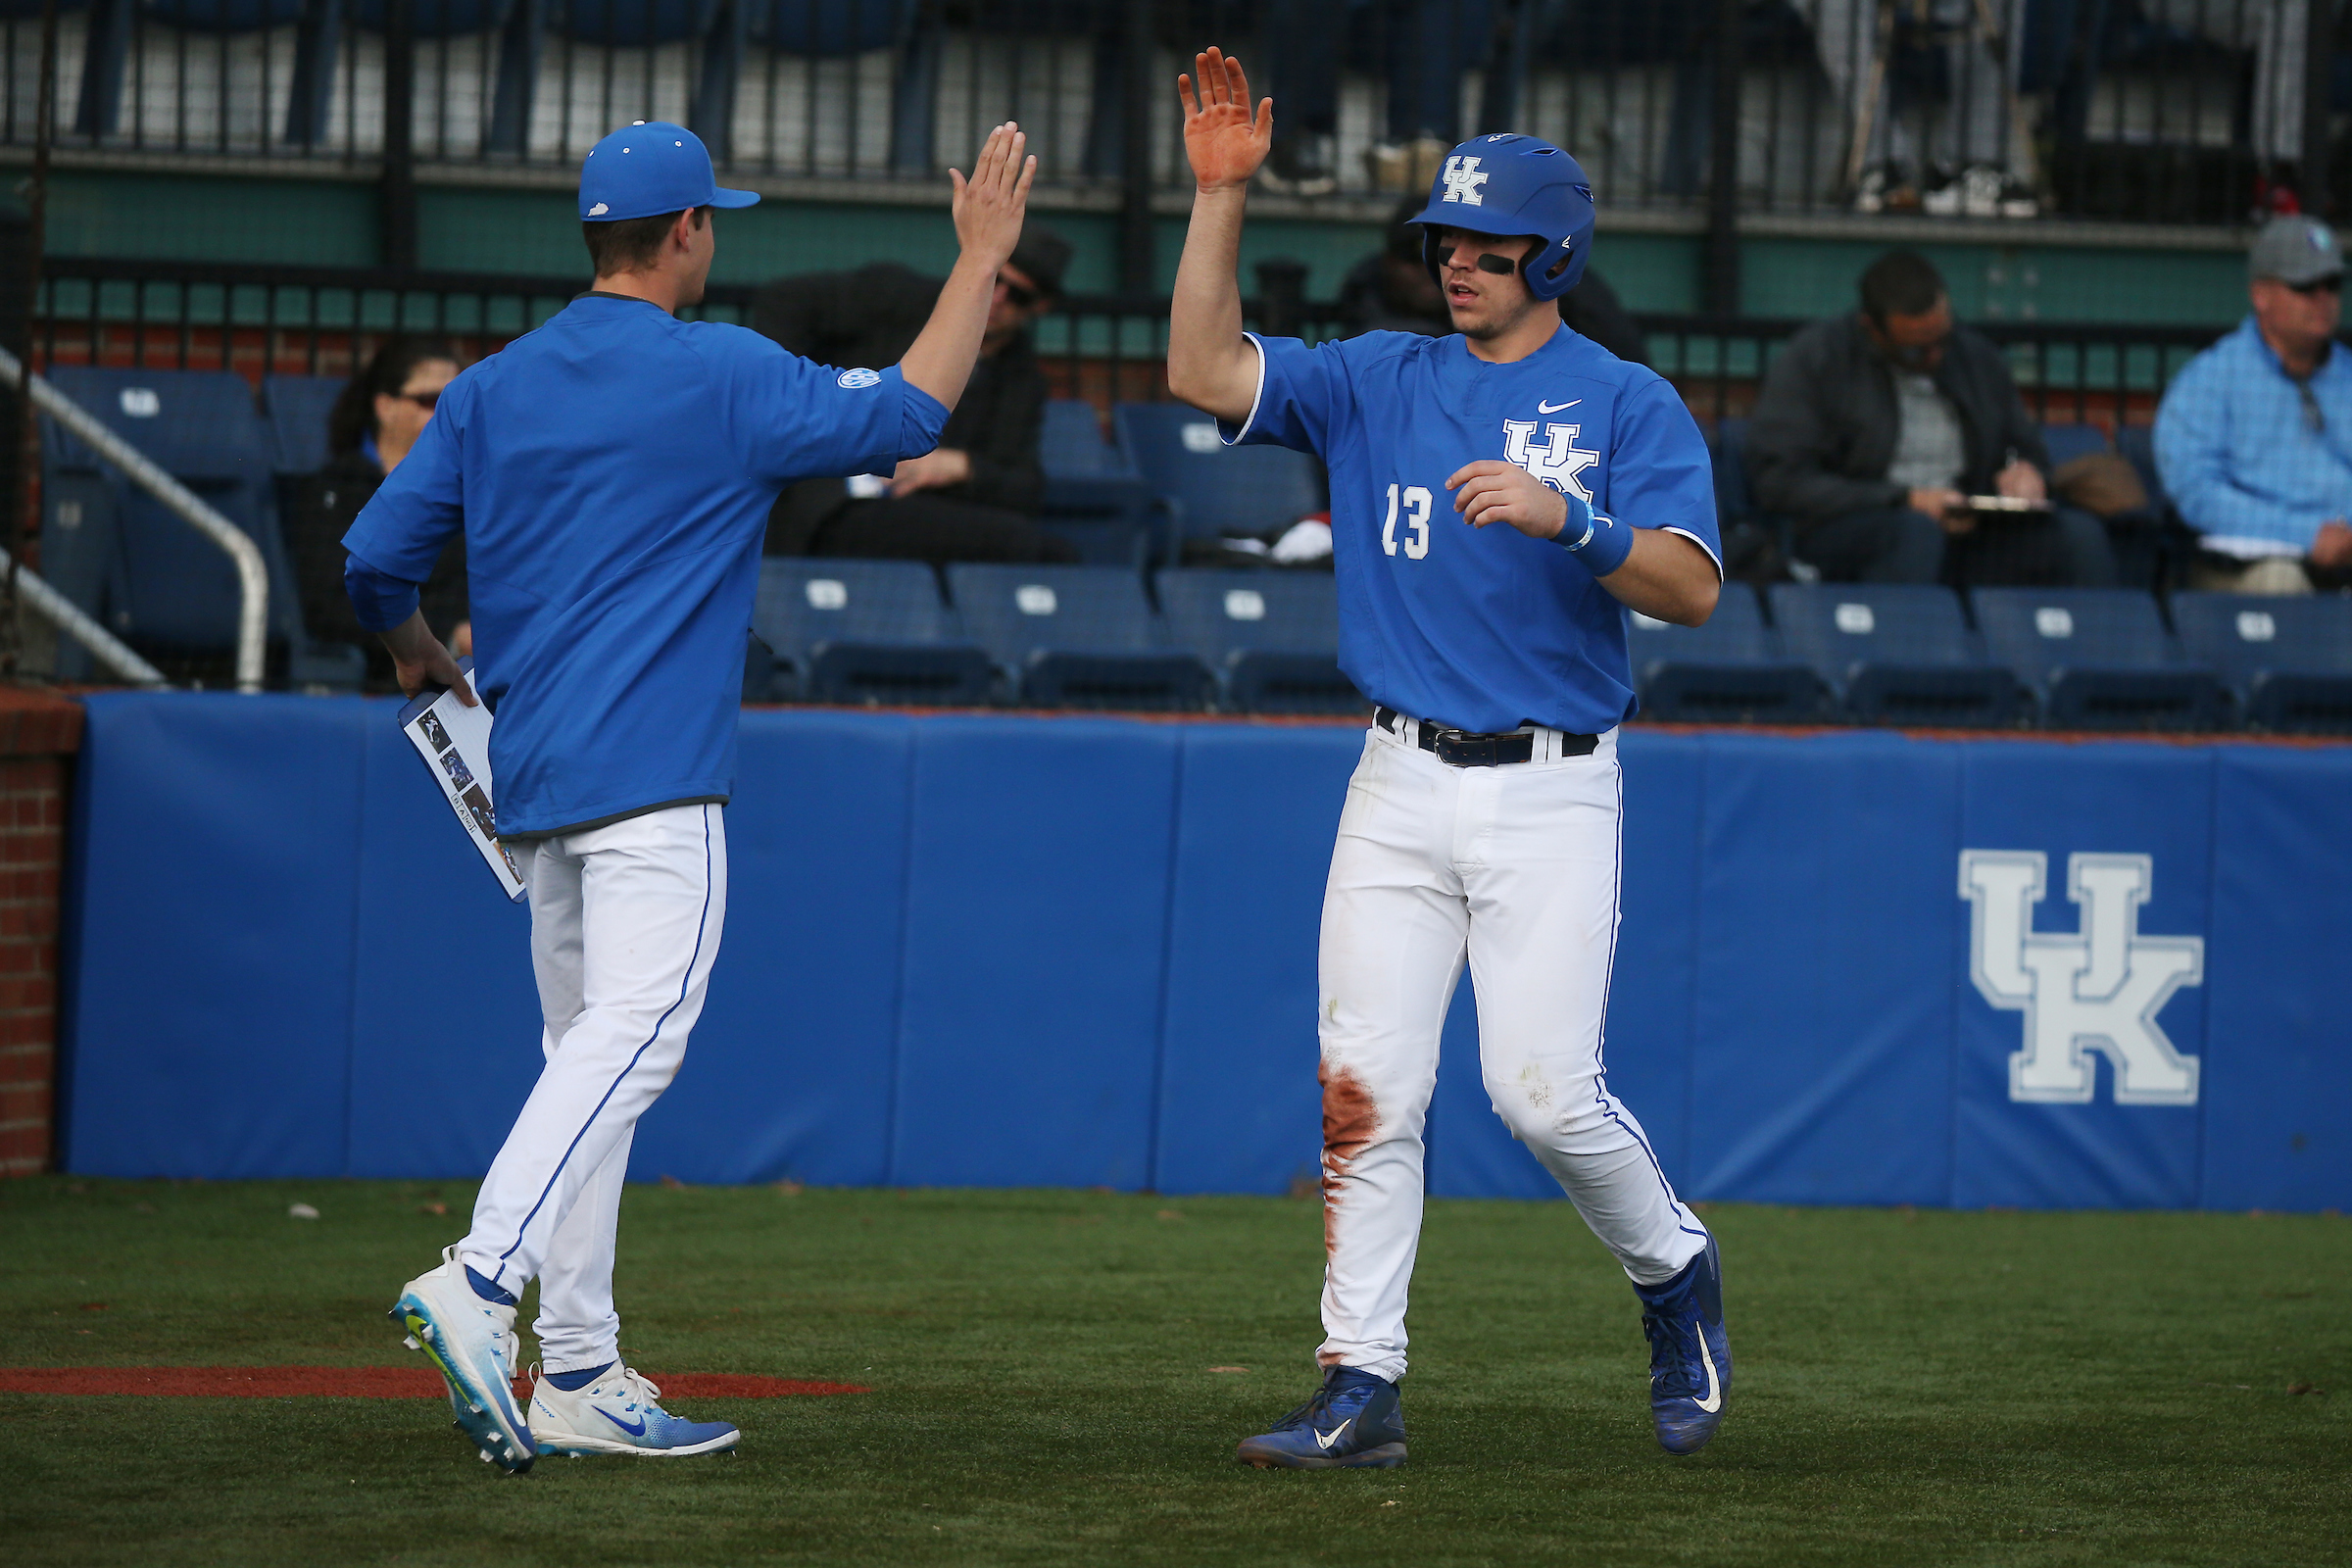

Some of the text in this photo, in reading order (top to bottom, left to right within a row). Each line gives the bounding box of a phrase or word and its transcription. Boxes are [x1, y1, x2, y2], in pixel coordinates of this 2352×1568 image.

[1443, 155, 1490, 206] UK
[1502, 418, 1599, 502] UK
[1381, 483, 1433, 560] 13
[1958, 849, 2204, 1105] UK
